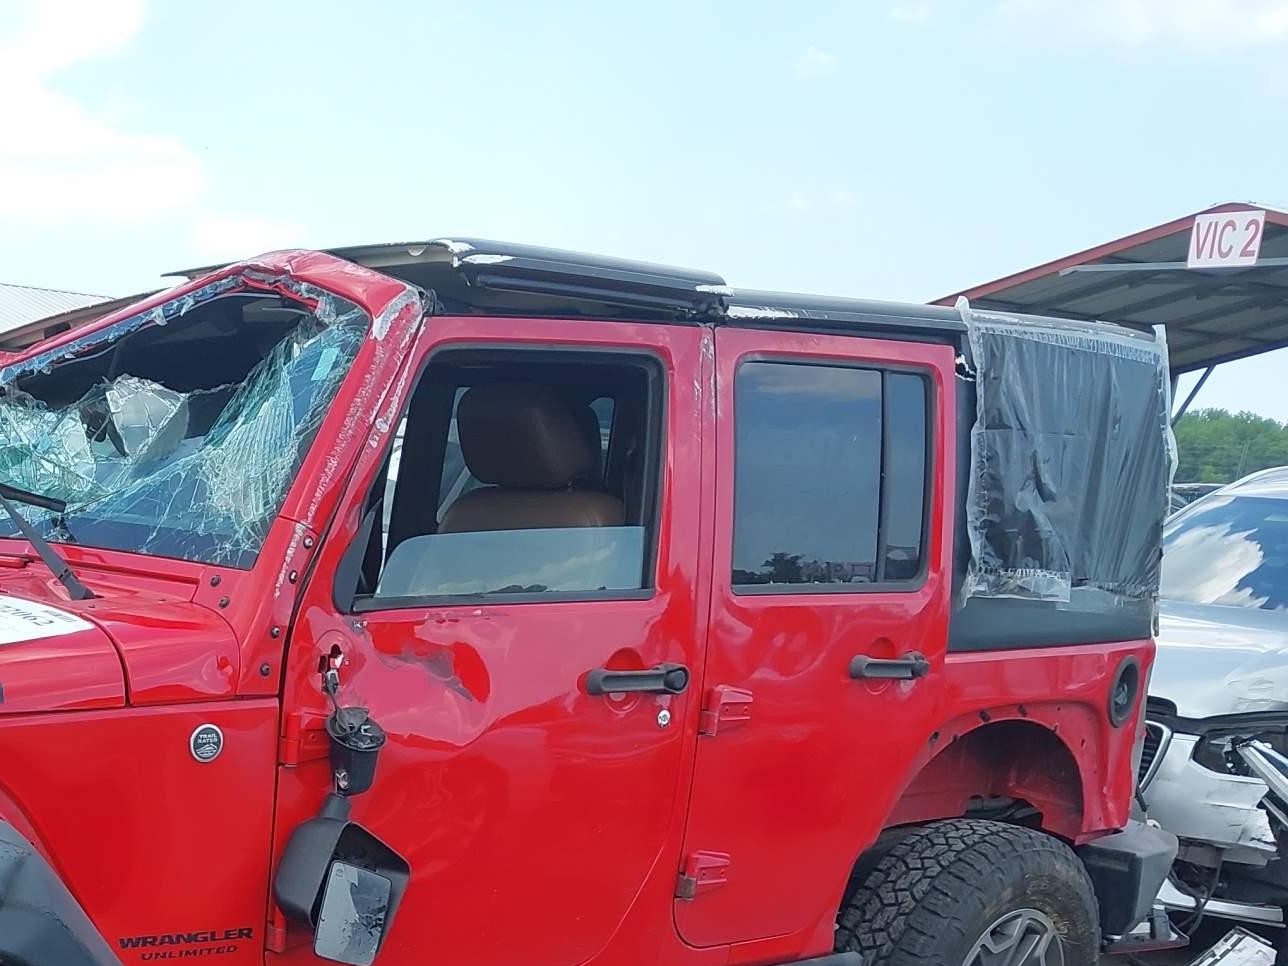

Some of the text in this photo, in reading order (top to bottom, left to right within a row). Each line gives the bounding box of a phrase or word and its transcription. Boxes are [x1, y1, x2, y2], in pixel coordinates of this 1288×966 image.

[1196, 218, 1261, 259] VIC 2
[119, 927, 253, 949] WRANGLER
[141, 945, 238, 961] UNLIMITED
